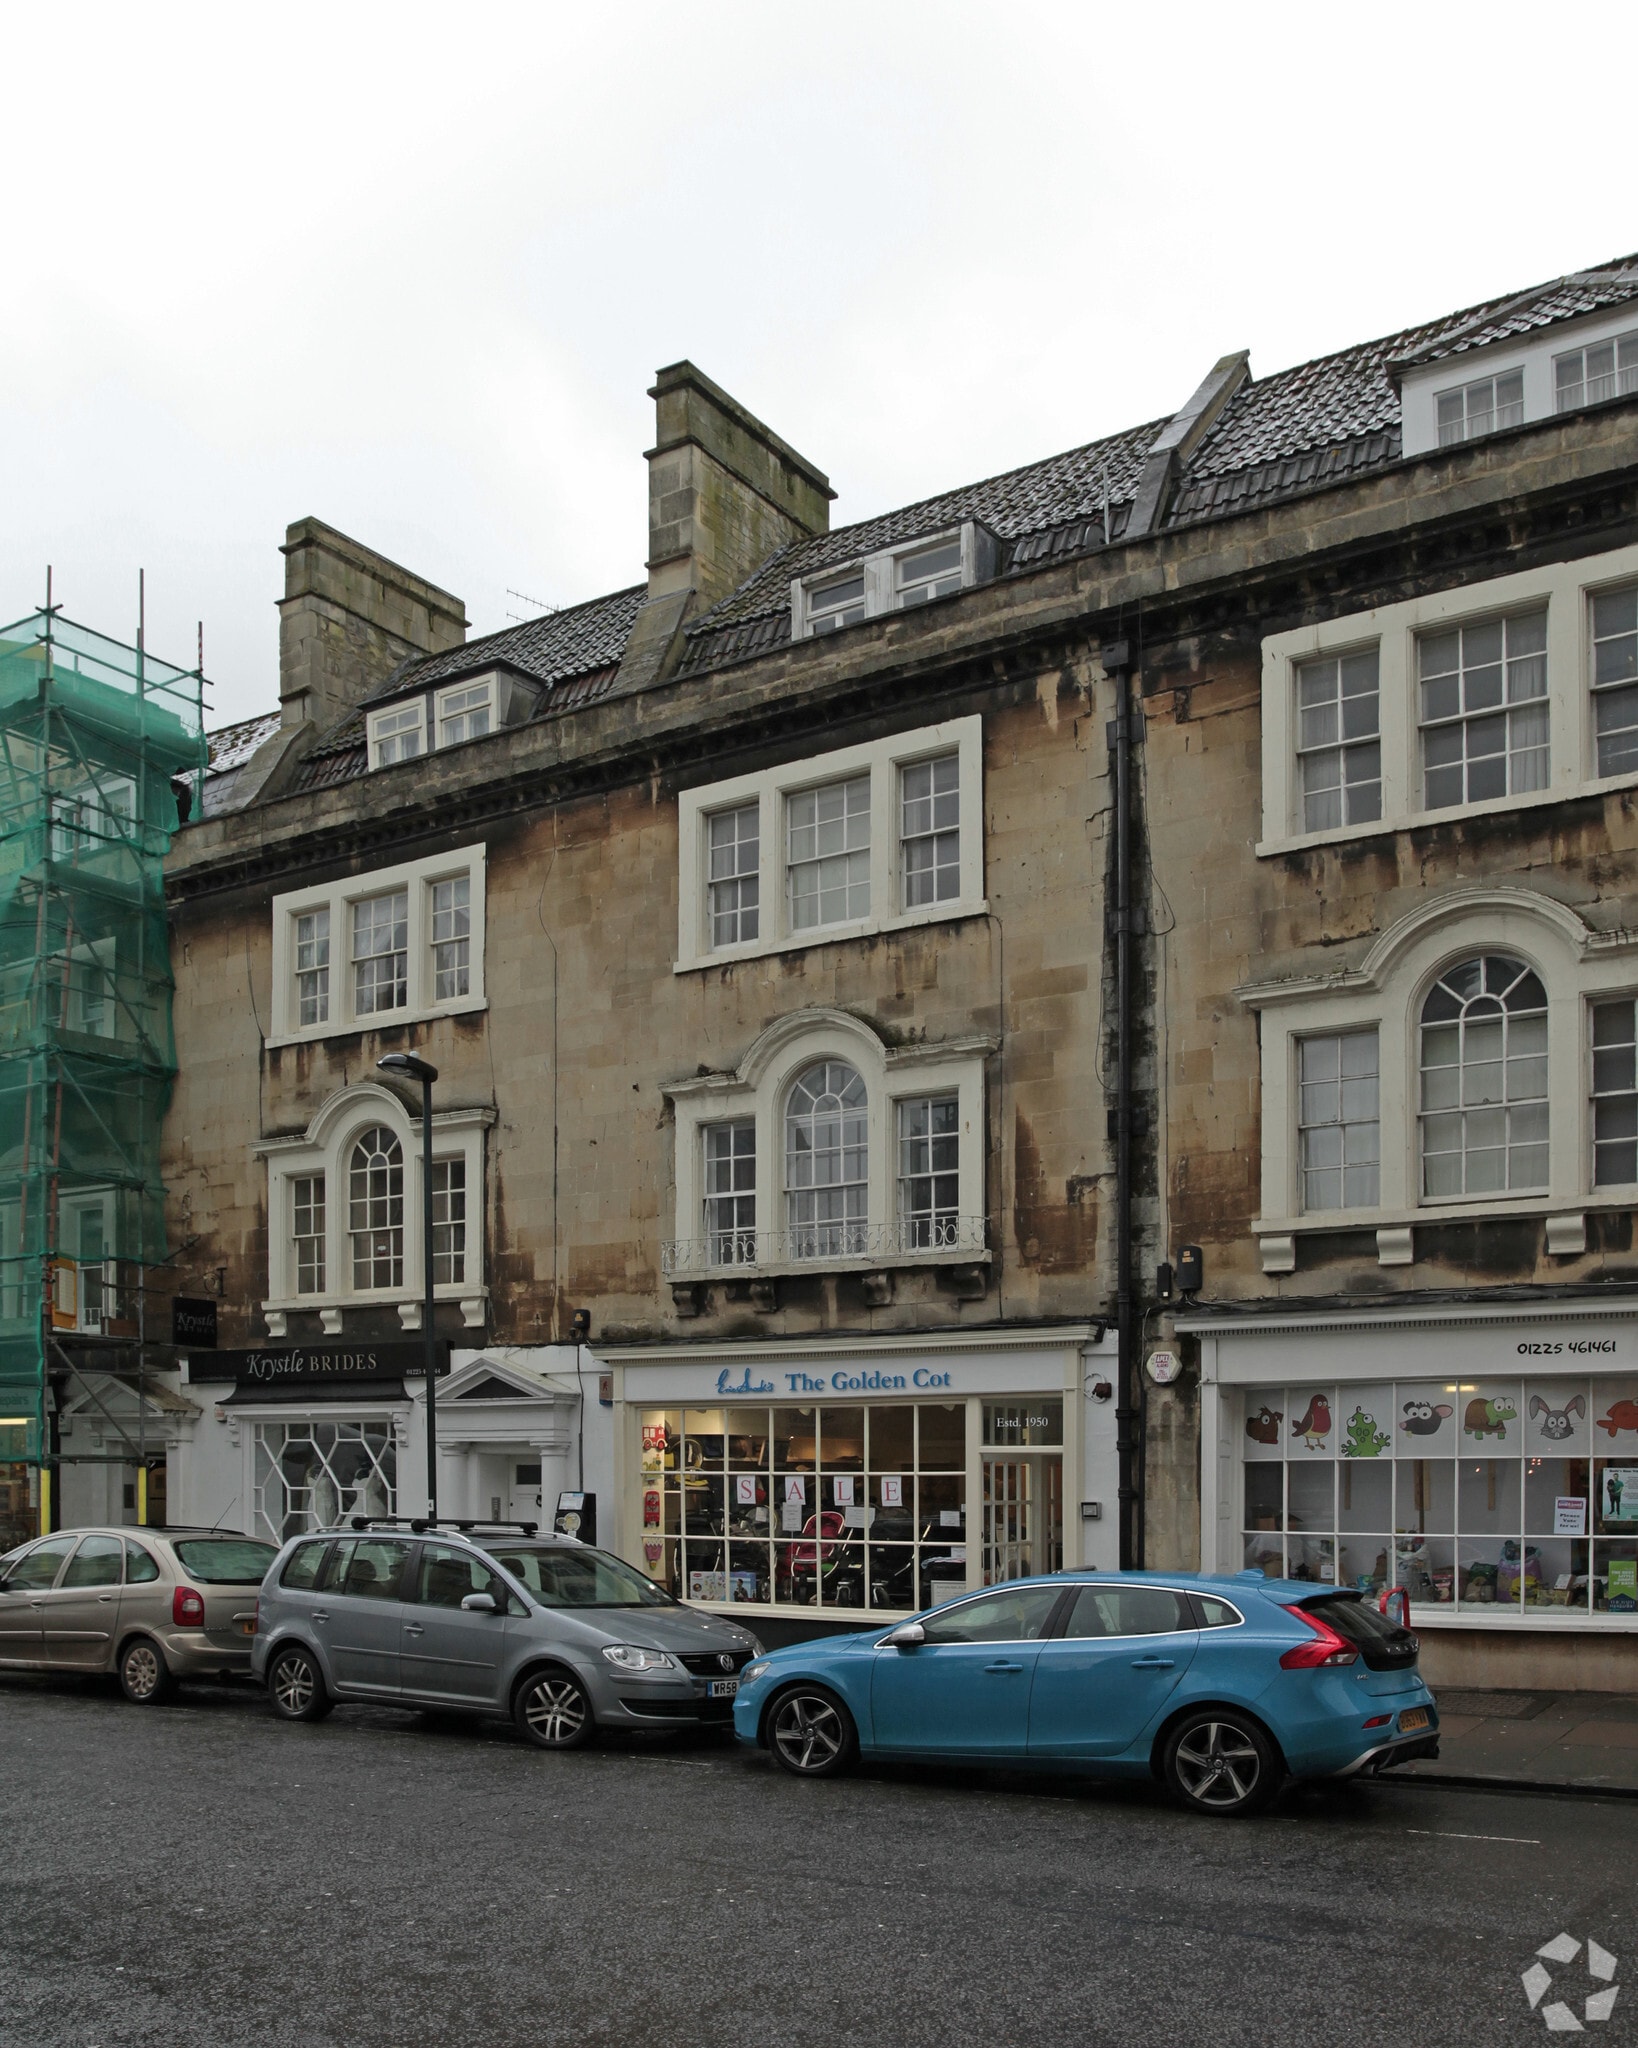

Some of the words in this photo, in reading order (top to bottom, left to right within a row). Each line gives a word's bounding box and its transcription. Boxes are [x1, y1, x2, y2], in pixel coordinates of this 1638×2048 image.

[1517, 1343, 1563, 1354] 01225
[1568, 1340, 1616, 1354] 461461
[247, 1350, 304, 1380] Krystle
[310, 1353, 377, 1371] BRIDES
[785, 1373, 825, 1392] The
[831, 1370, 906, 1391] Golden
[912, 1368, 951, 1388] Cot
[996, 1417, 1022, 1428] Estd.
[1025, 1416, 1049, 1427] 1950
[713, 1682, 738, 1695] WR58
